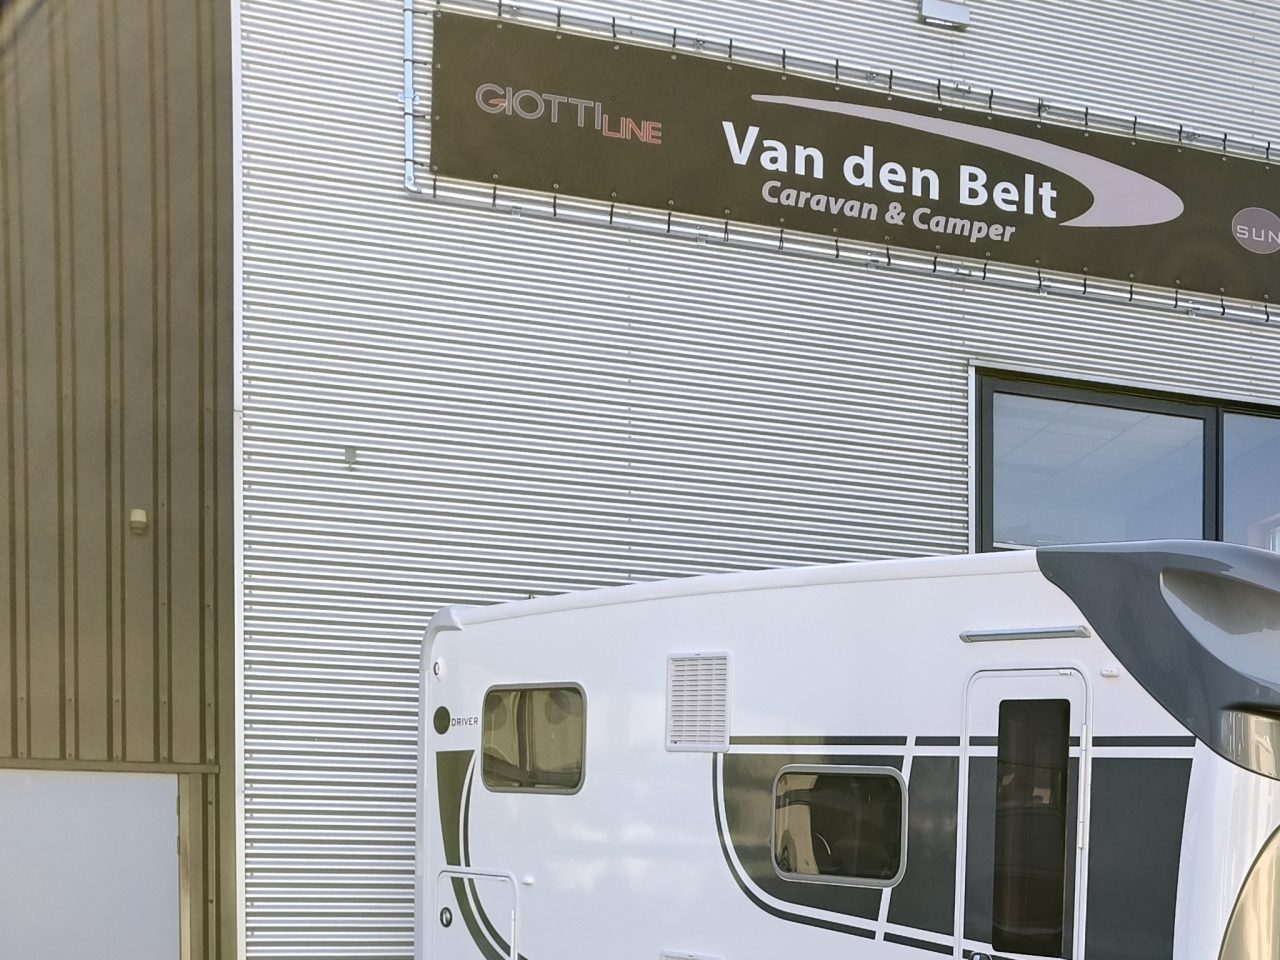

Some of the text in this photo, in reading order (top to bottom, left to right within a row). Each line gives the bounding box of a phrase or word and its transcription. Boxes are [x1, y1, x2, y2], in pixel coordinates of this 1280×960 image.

[722, 120, 1058, 219] Van den Belt
[761, 180, 1016, 243] Caravan & Camper
